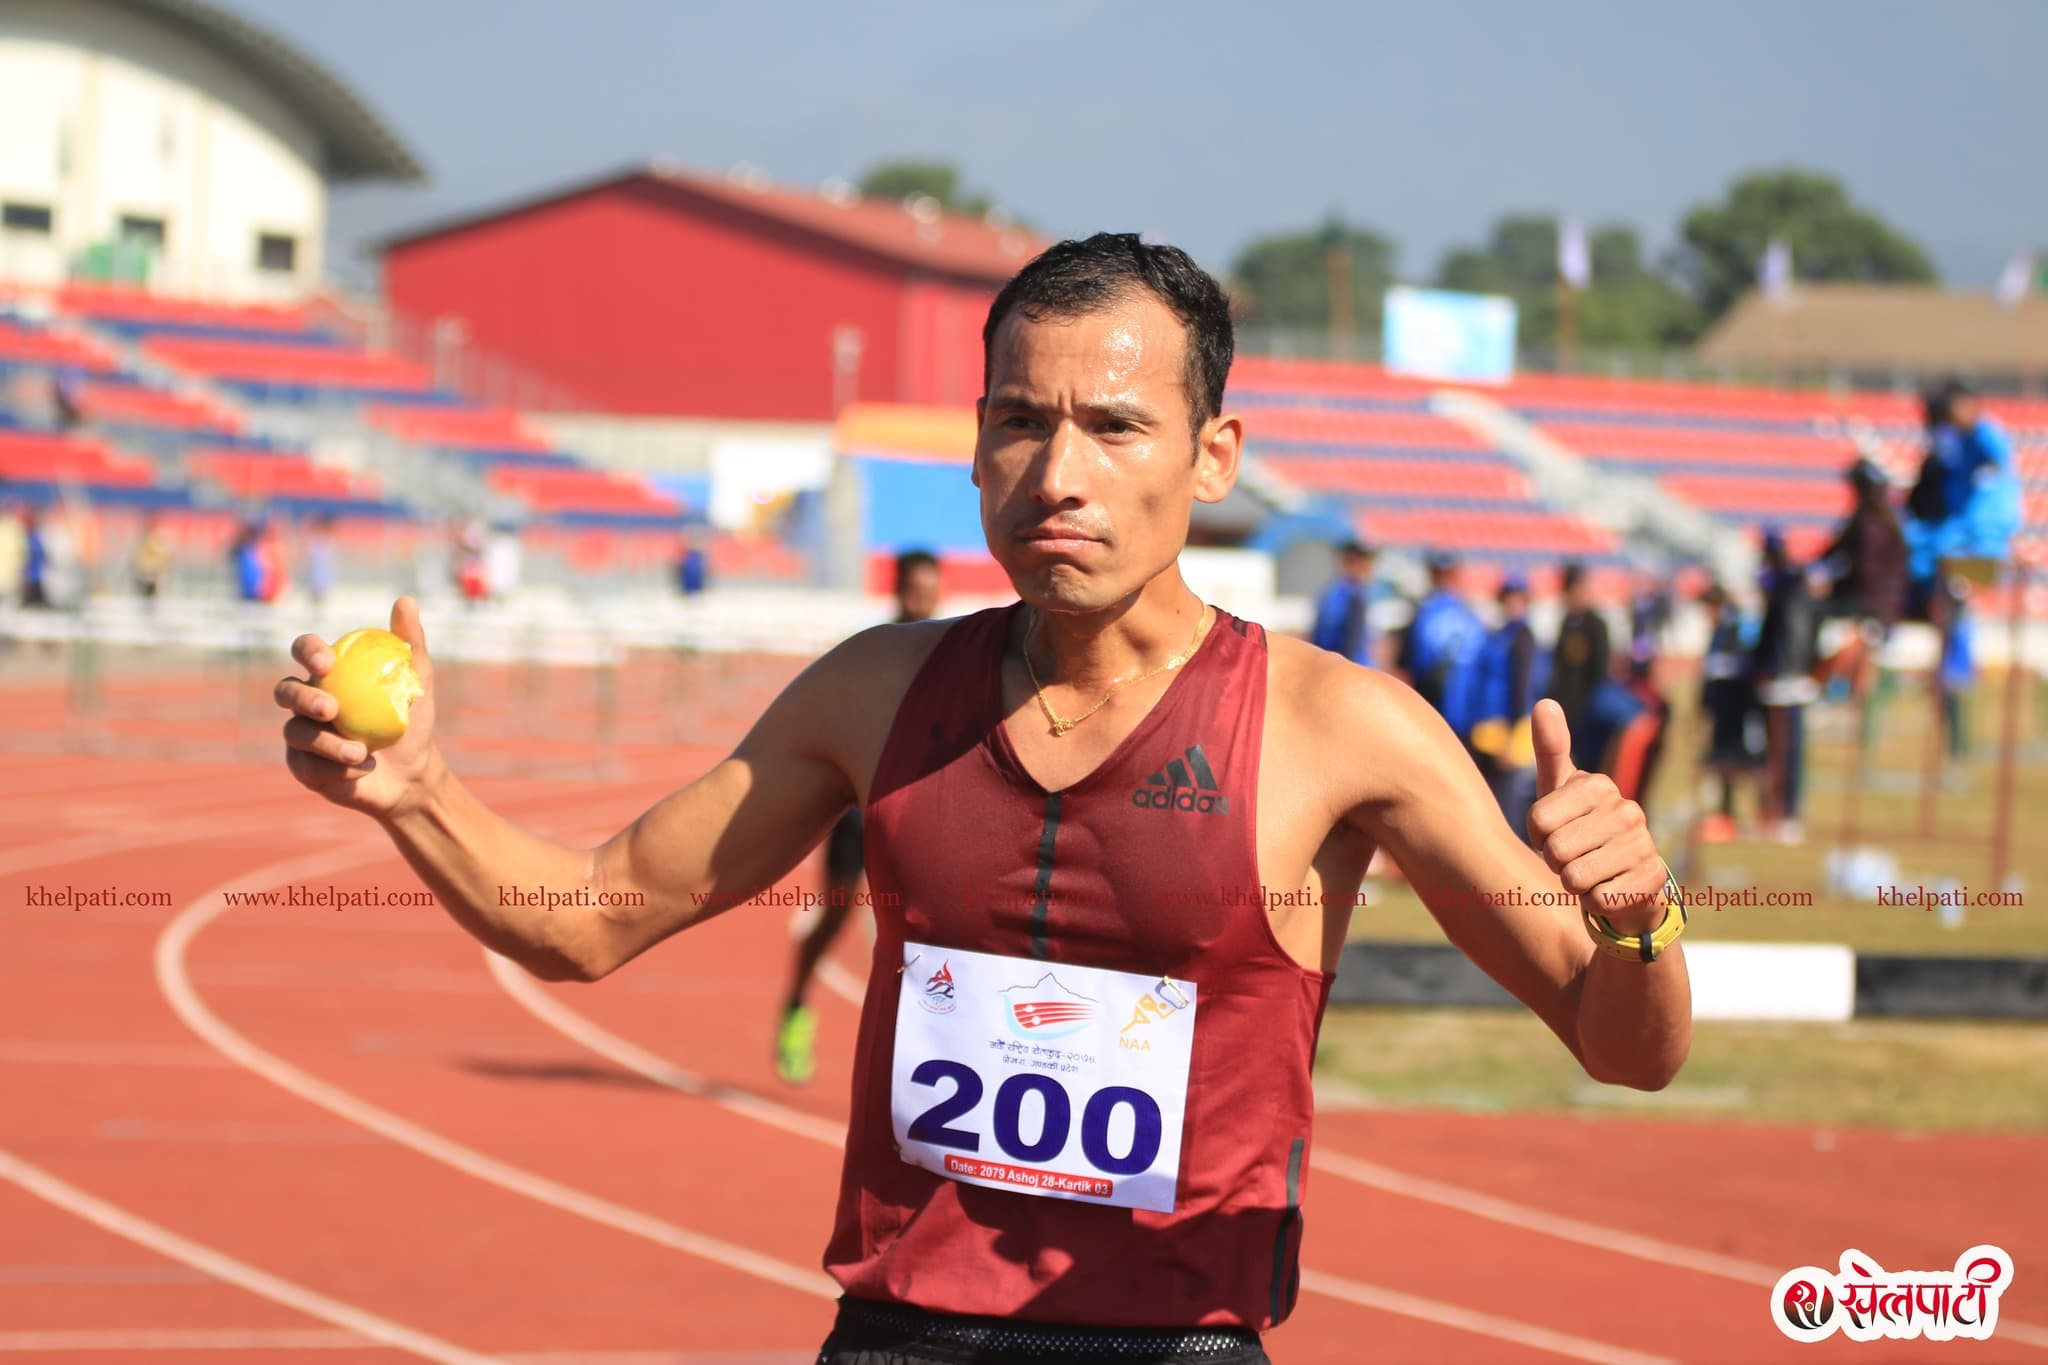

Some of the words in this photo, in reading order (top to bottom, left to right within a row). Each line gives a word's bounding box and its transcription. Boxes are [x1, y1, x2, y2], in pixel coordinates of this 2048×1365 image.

[1132, 784, 1230, 815] adidas
[1119, 1036, 1151, 1051] NAA
[907, 1059, 1162, 1175] 200
[950, 1158, 978, 1176] Date:
[979, 1164, 1005, 1180] 2079
[1007, 1168, 1039, 1188] Ashoj
[1041, 1174, 1092, 1193] 28-Kartik
[1094, 1183, 1109, 1195] 03
